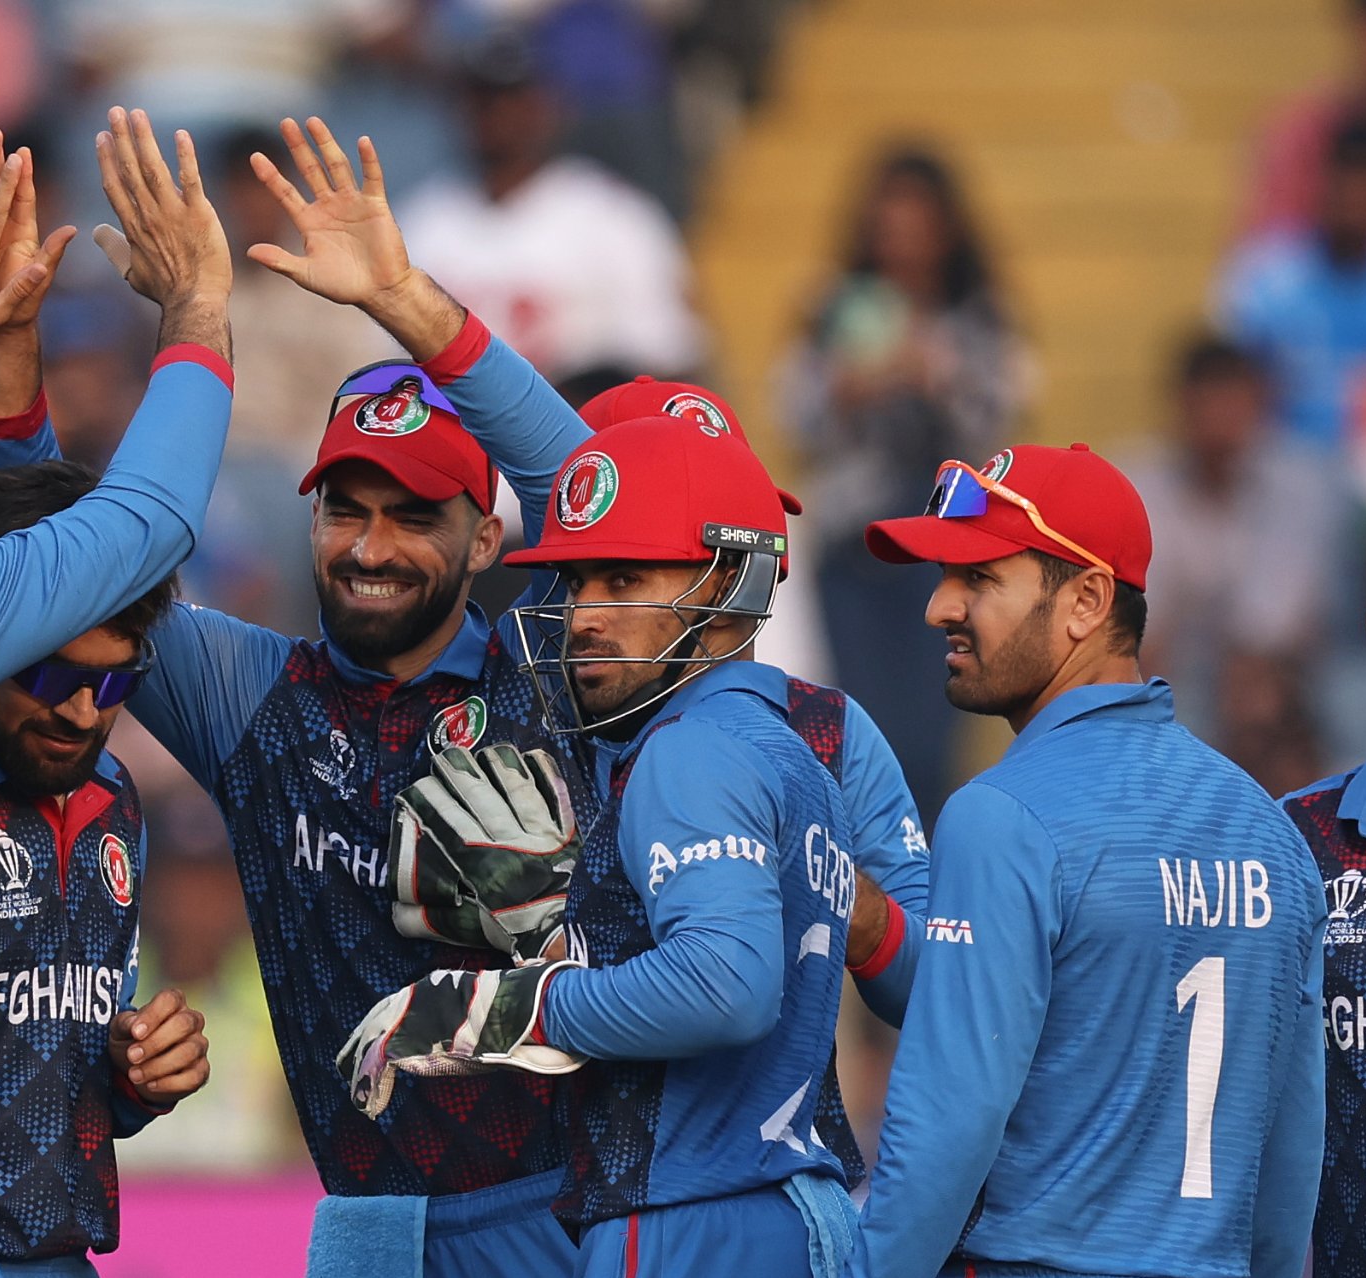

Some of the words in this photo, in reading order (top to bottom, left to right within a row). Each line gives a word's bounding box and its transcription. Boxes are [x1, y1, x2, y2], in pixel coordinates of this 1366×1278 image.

[720, 527, 760, 545] SHREY
[1158, 858, 1273, 929] NAJIB
[18, 905, 39, 917] 2023
[1334, 935, 1364, 944] 2023
[1175, 956, 1225, 1199] 1
